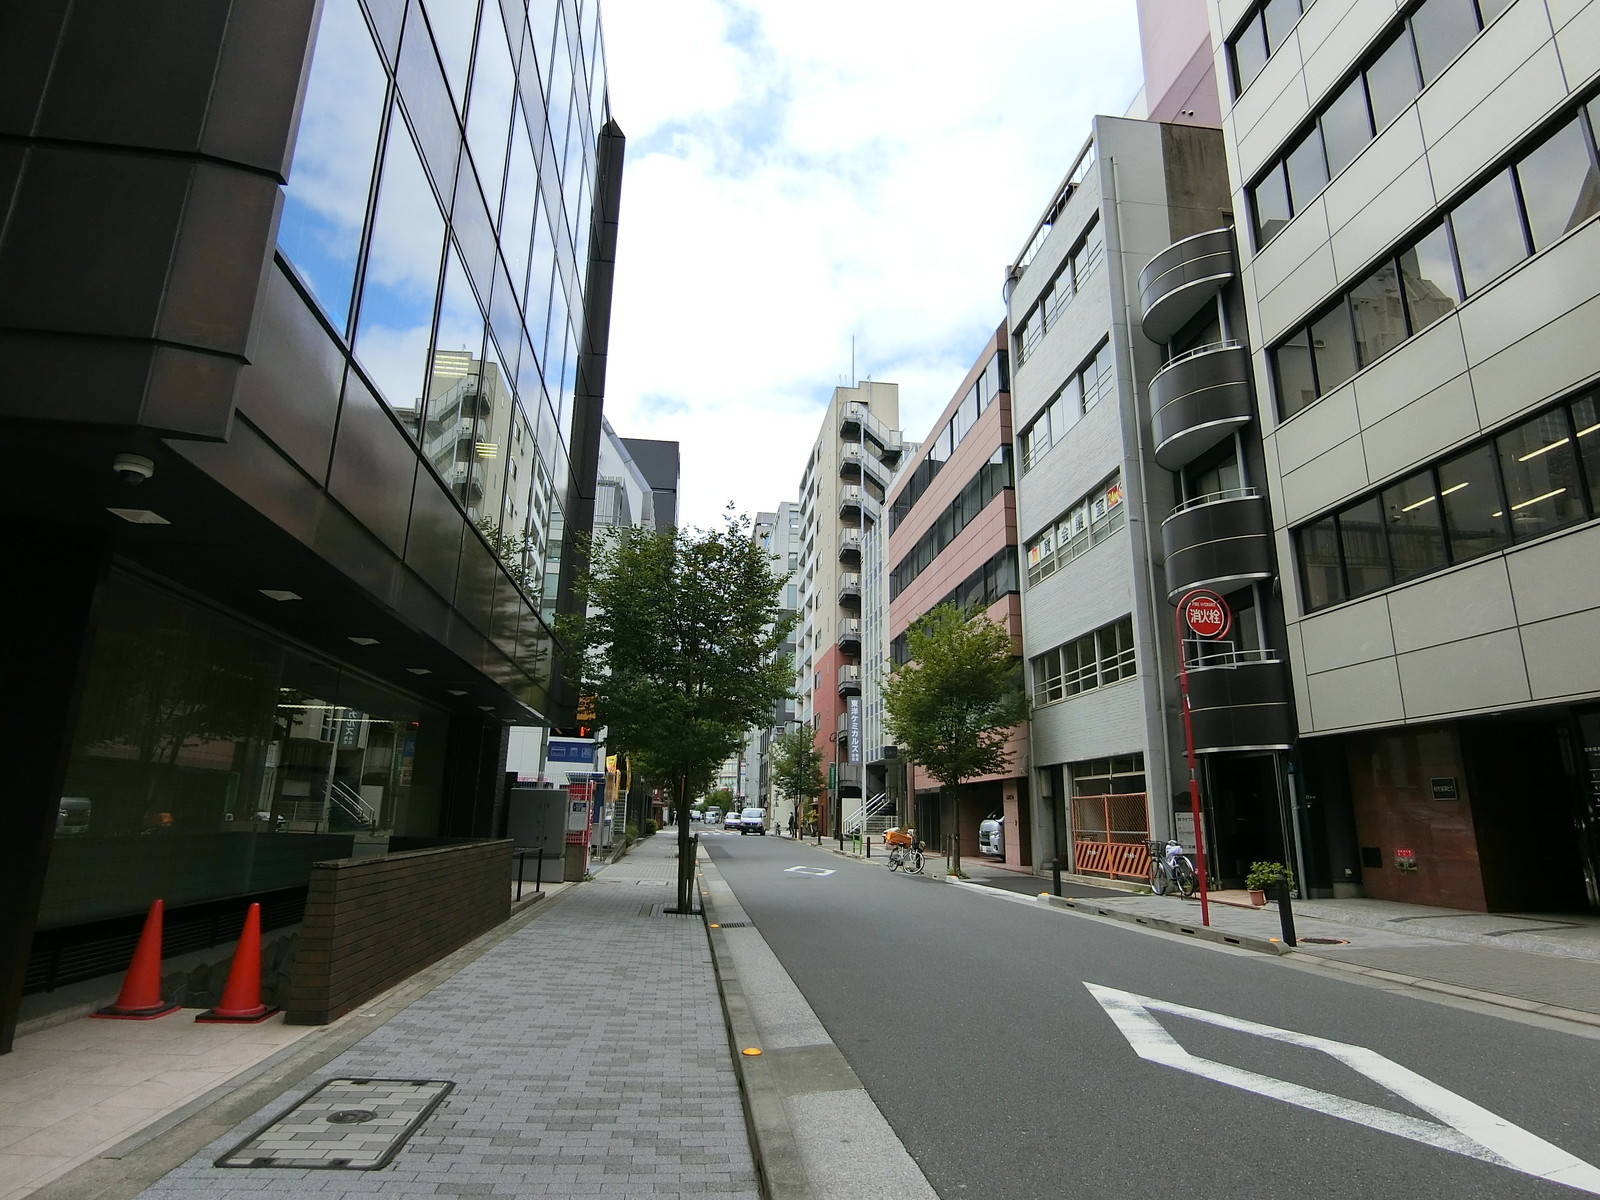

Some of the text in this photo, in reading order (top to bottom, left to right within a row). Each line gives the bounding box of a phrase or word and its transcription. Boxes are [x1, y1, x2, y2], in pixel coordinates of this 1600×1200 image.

[1189, 608, 1221, 624] 消火栓
[850, 699, 860, 753] 東洋ケミカルズ
